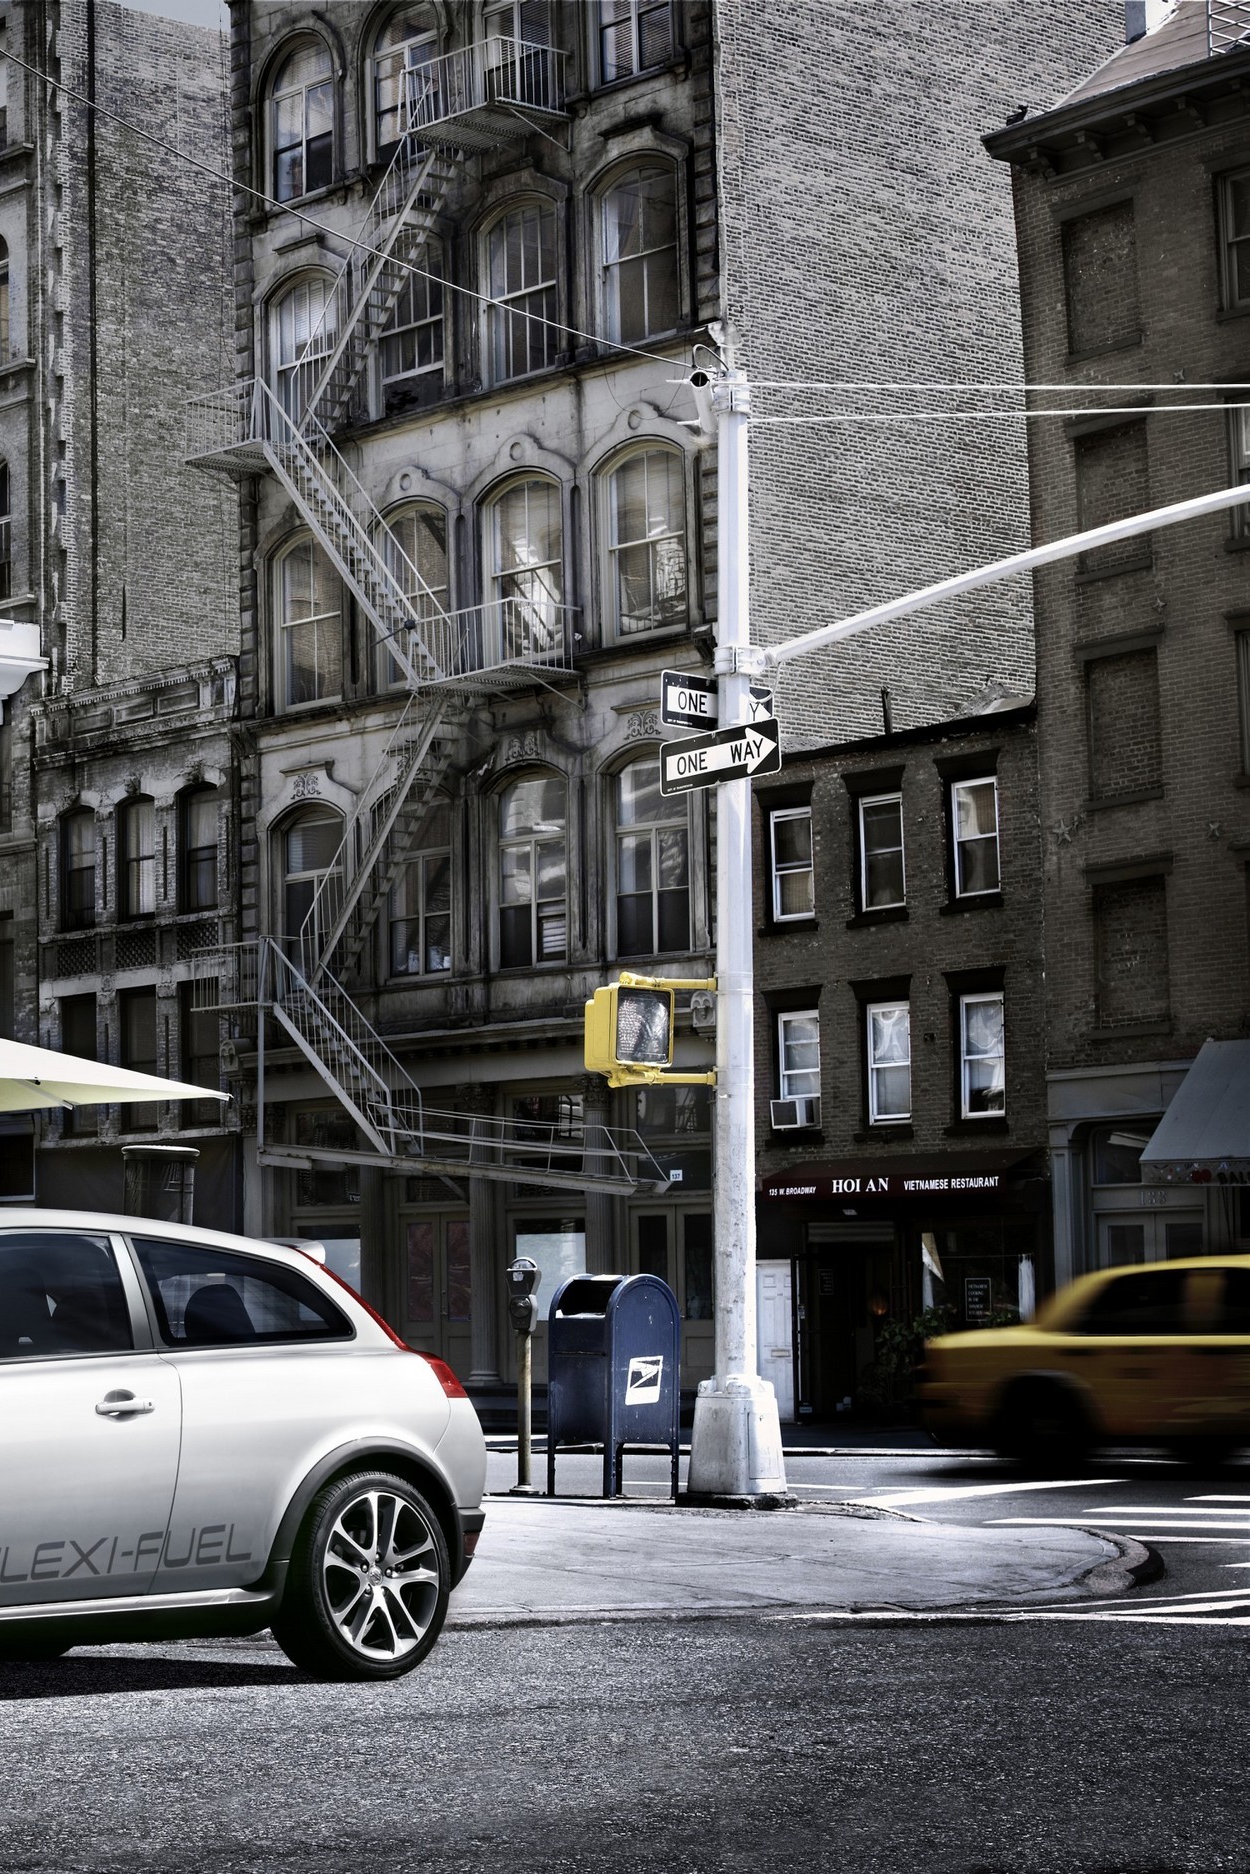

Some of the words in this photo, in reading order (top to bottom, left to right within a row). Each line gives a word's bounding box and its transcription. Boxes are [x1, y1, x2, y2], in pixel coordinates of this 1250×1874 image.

[678, 691, 707, 714] ONE
[677, 751, 708, 775] ONE
[730, 738, 764, 764] WAY
[786, 1186, 817, 1195] BROADWAY
[832, 1178, 861, 1193] HOI
[865, 1177, 889, 1192] AN
[904, 1179, 949, 1191] VIETNAMESE
[951, 1176, 999, 1189] RESTAURANT
